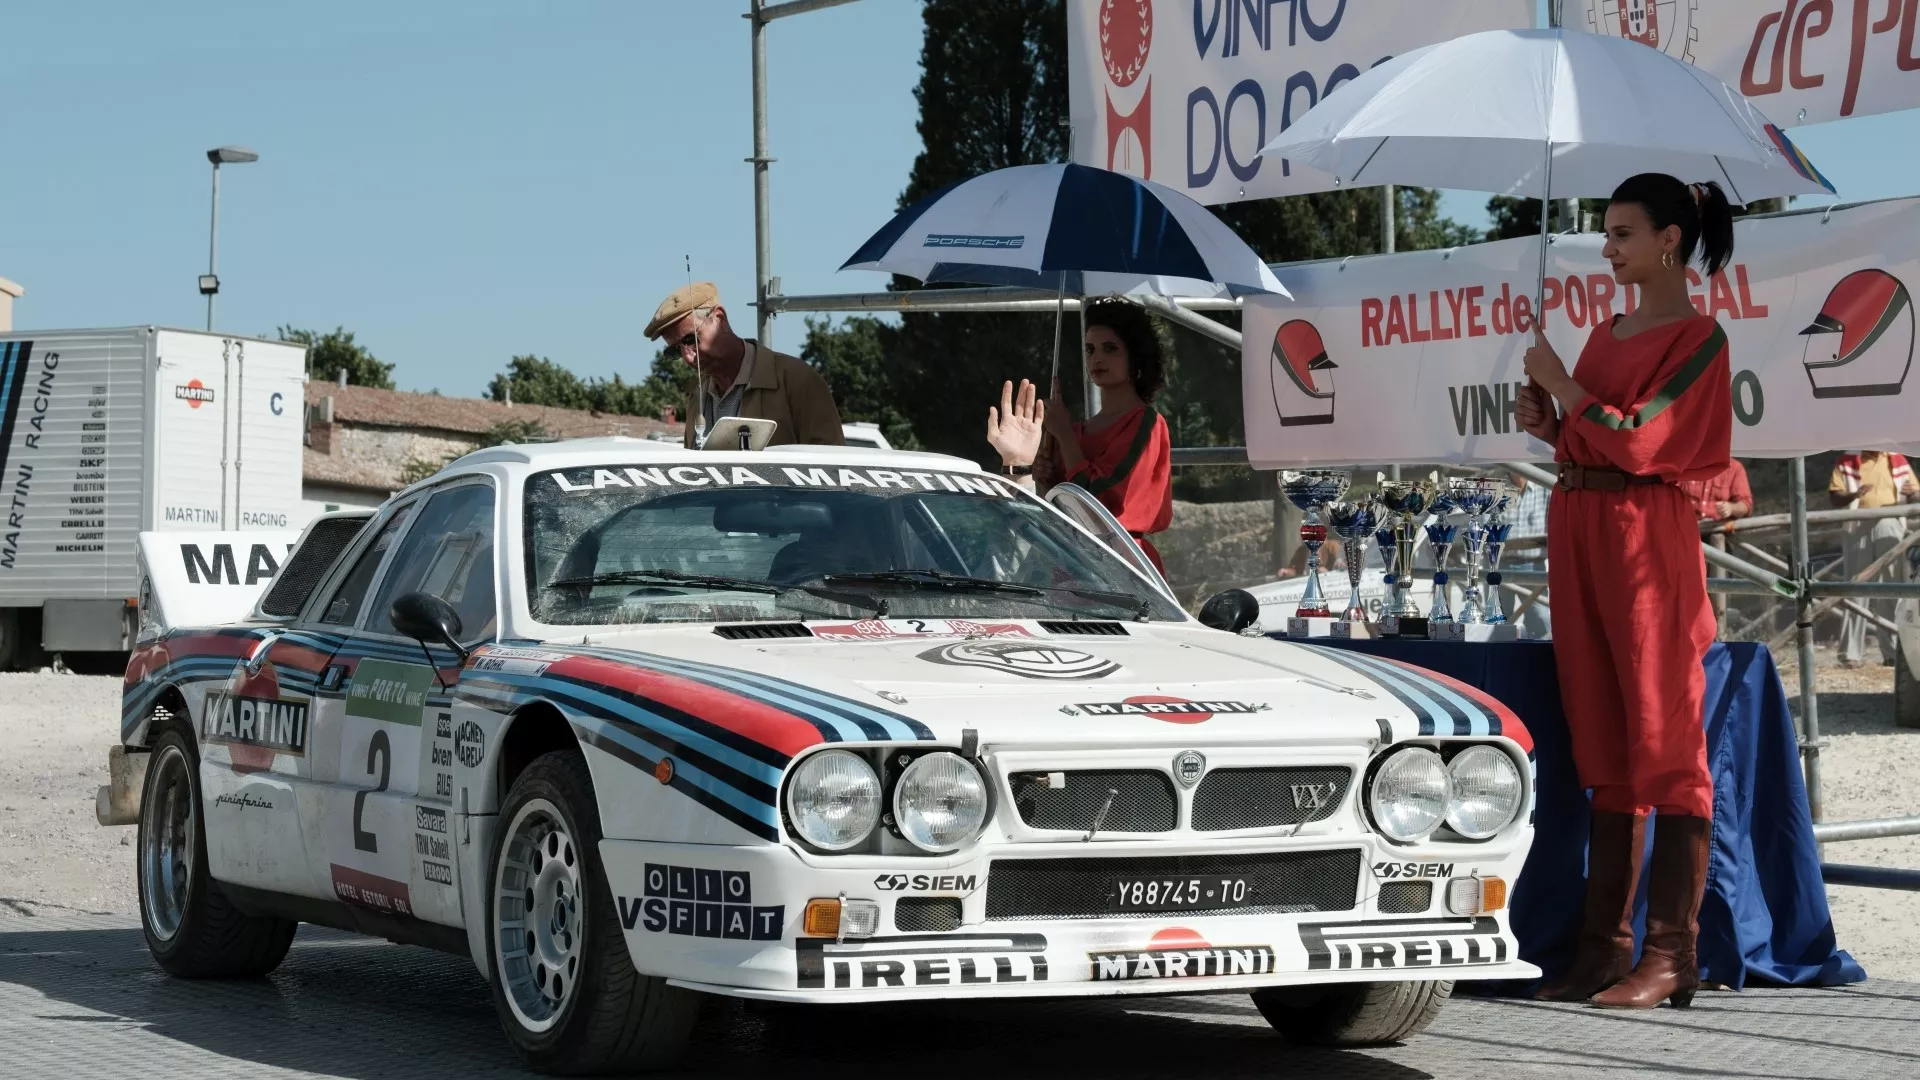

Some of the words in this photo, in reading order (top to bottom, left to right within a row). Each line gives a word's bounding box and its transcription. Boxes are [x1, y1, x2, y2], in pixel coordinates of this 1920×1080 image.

[1187, 79, 1265, 189] DO
[925, 237, 1023, 246] PORSCHE
[1361, 285, 1487, 347] RALLYE
[1492, 284, 1532, 335] de
[176, 385, 214, 402] MARTINI
[270, 392, 284, 415] C
[0, 464, 34, 569] MARTINI
[25, 351, 60, 449] RACING
[80, 459, 105, 467] SKF
[73, 483, 105, 491] BILSTEIN
[551, 466, 770, 492] LANCIA
[780, 467, 1016, 498] MARTINI
[165, 507, 219, 524] MARTINI
[242, 512, 287, 527] RACING
[180, 543, 299, 585] MA
[852, 620, 890, 634] 1983
[907, 620, 933, 632] 2
[369, 679, 408, 703] PORTO
[406, 691, 423, 706] WINE
[1088, 702, 1254, 713] MARTINI
[205, 696, 306, 747] MARTINI
[455, 721, 484, 746] MAGNETI
[455, 746, 484, 768] MARELLI
[215, 793, 273, 810] pininfarina
[353, 729, 391, 853] 2
[1290, 784, 1324, 810] VX
[417, 808, 446, 831] Savara
[416, 833, 430, 854] TRW
[424, 864, 450, 883] FERODO
[1402, 863, 1454, 877] SIEM
[648, 868, 746, 898] OLIO
[911, 875, 976, 891] SIEM
[1118, 880, 1199, 905] Y88745
[1221, 879, 1246, 902] TO
[336, 881, 359, 900] HOTEL
[361, 888, 392, 909] ESTORIL
[394, 897, 410, 914] SOL
[618, 896, 668, 932] VS
[1298, 917, 1507, 969] PIRELLI
[796, 933, 1048, 989] PIRELLI
[1098, 949, 1268, 980] MARTINI
